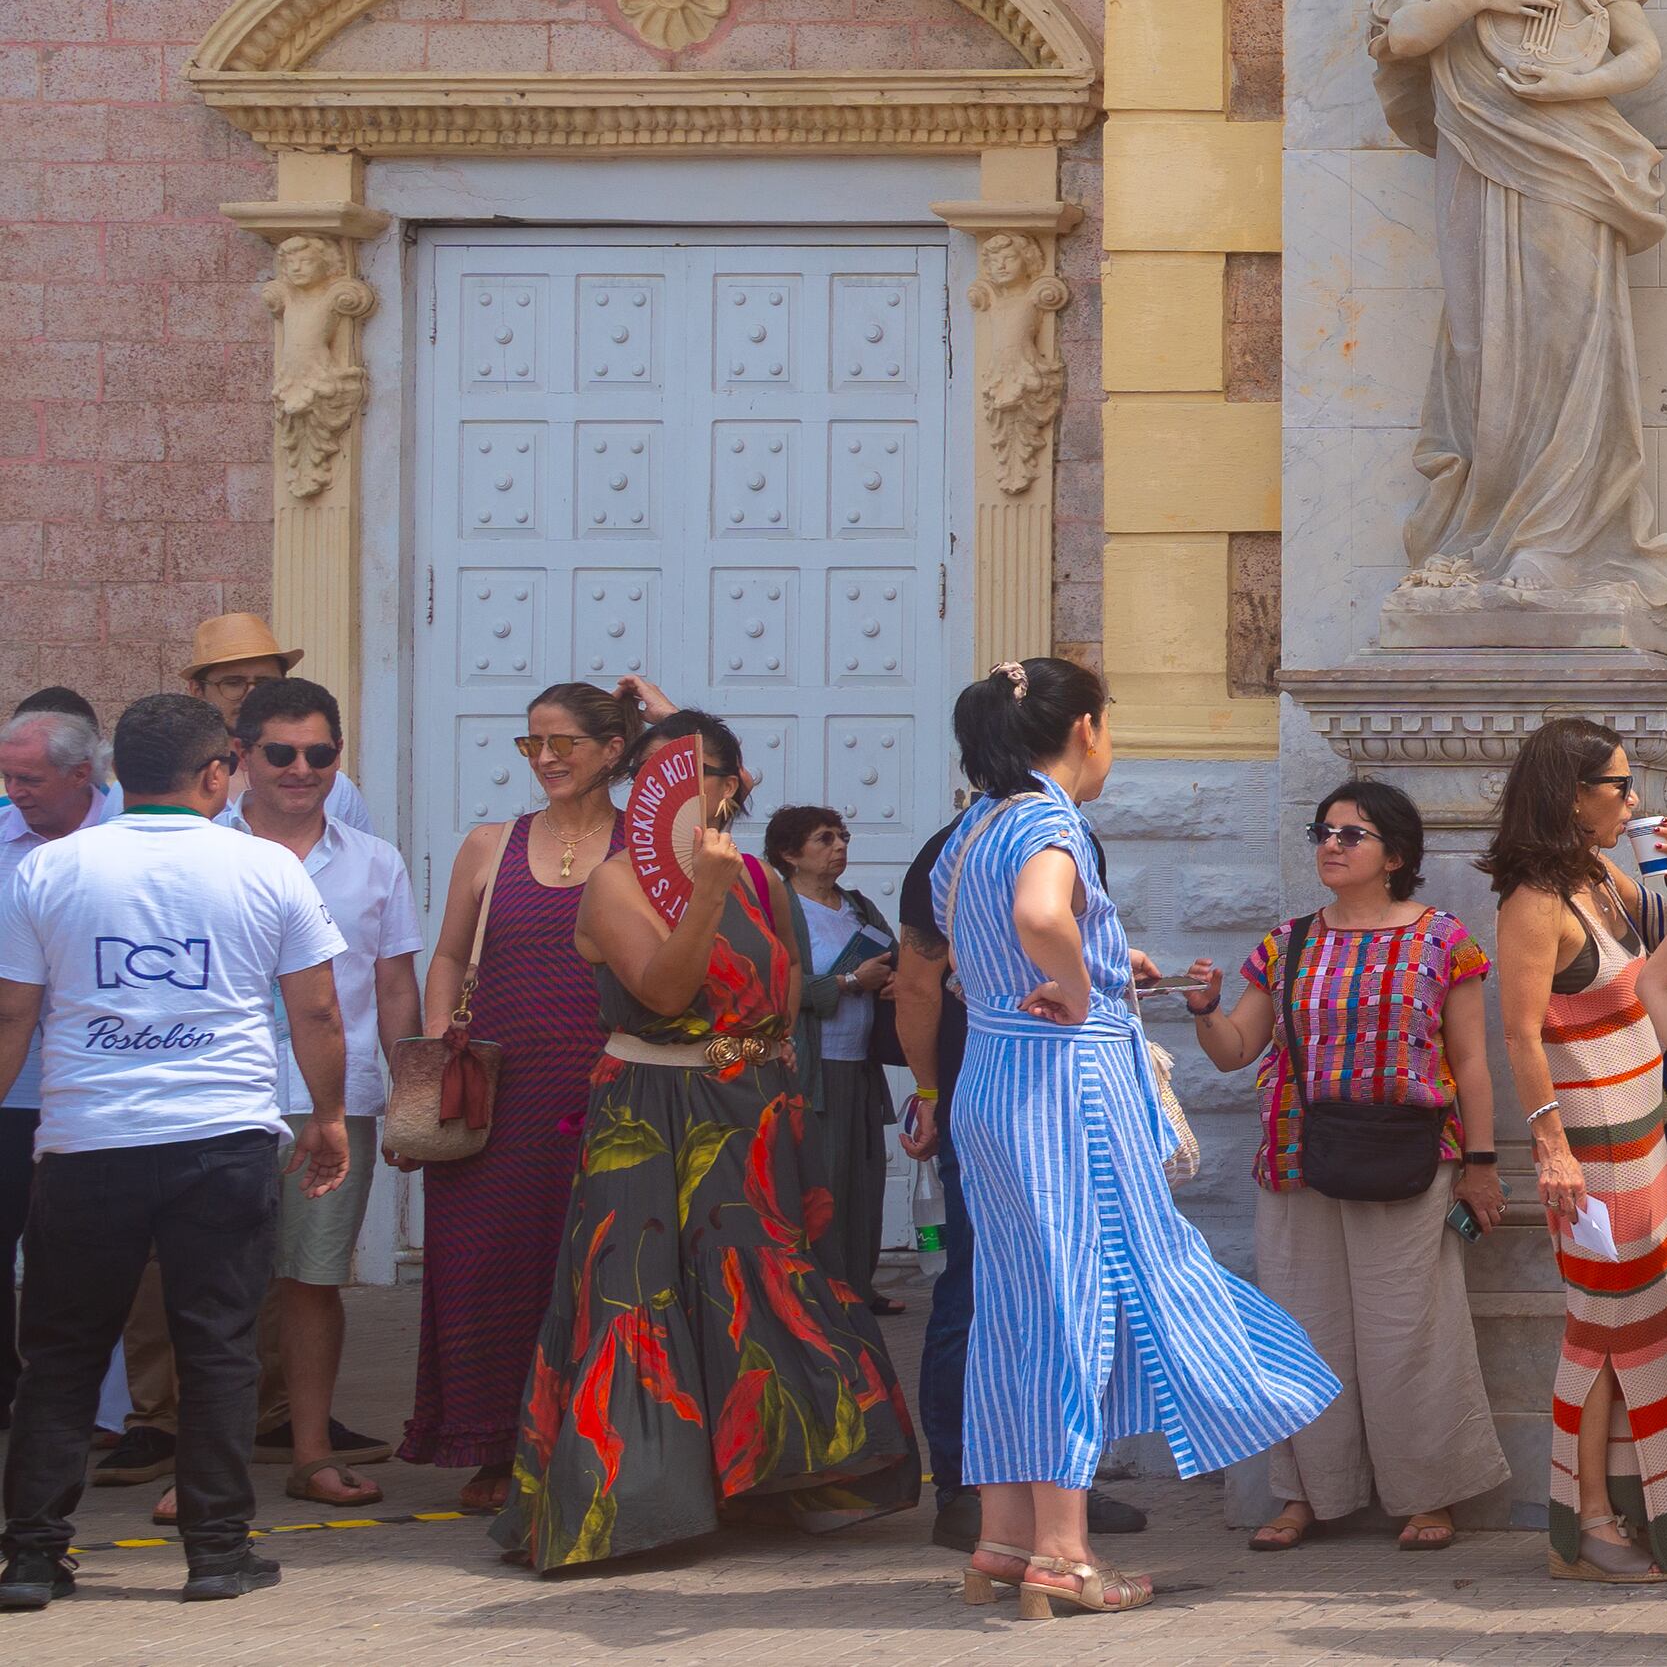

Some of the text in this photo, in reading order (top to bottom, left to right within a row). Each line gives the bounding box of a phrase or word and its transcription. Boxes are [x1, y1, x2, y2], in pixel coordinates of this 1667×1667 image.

[632, 749, 695, 923] IT'S FUCKING HOT
[85, 1015, 215, 1050] Postobón
